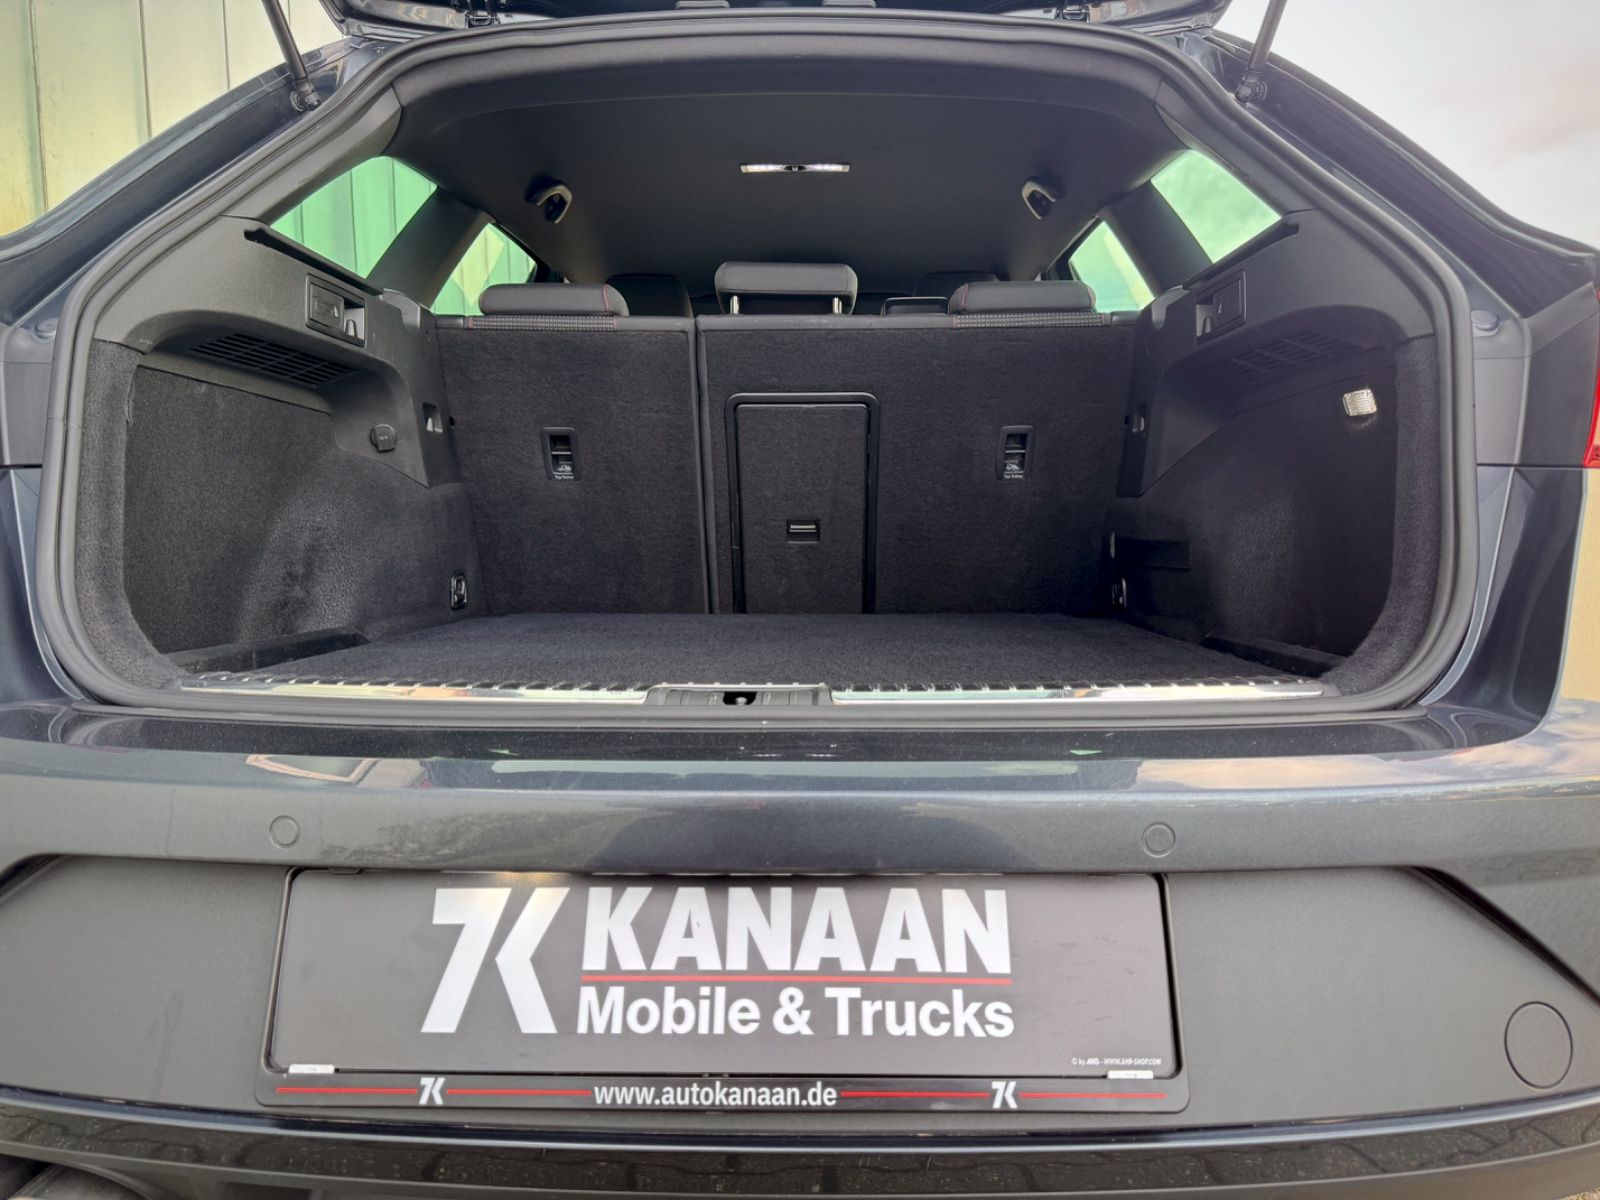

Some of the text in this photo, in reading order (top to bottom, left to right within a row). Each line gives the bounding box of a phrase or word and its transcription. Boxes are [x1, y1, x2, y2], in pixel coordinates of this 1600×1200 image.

[582, 887, 1012, 974] KANAAN
[577, 986, 1015, 1038] Mobile & Trucks
[594, 1081, 837, 1107] www.autokanaan.de
